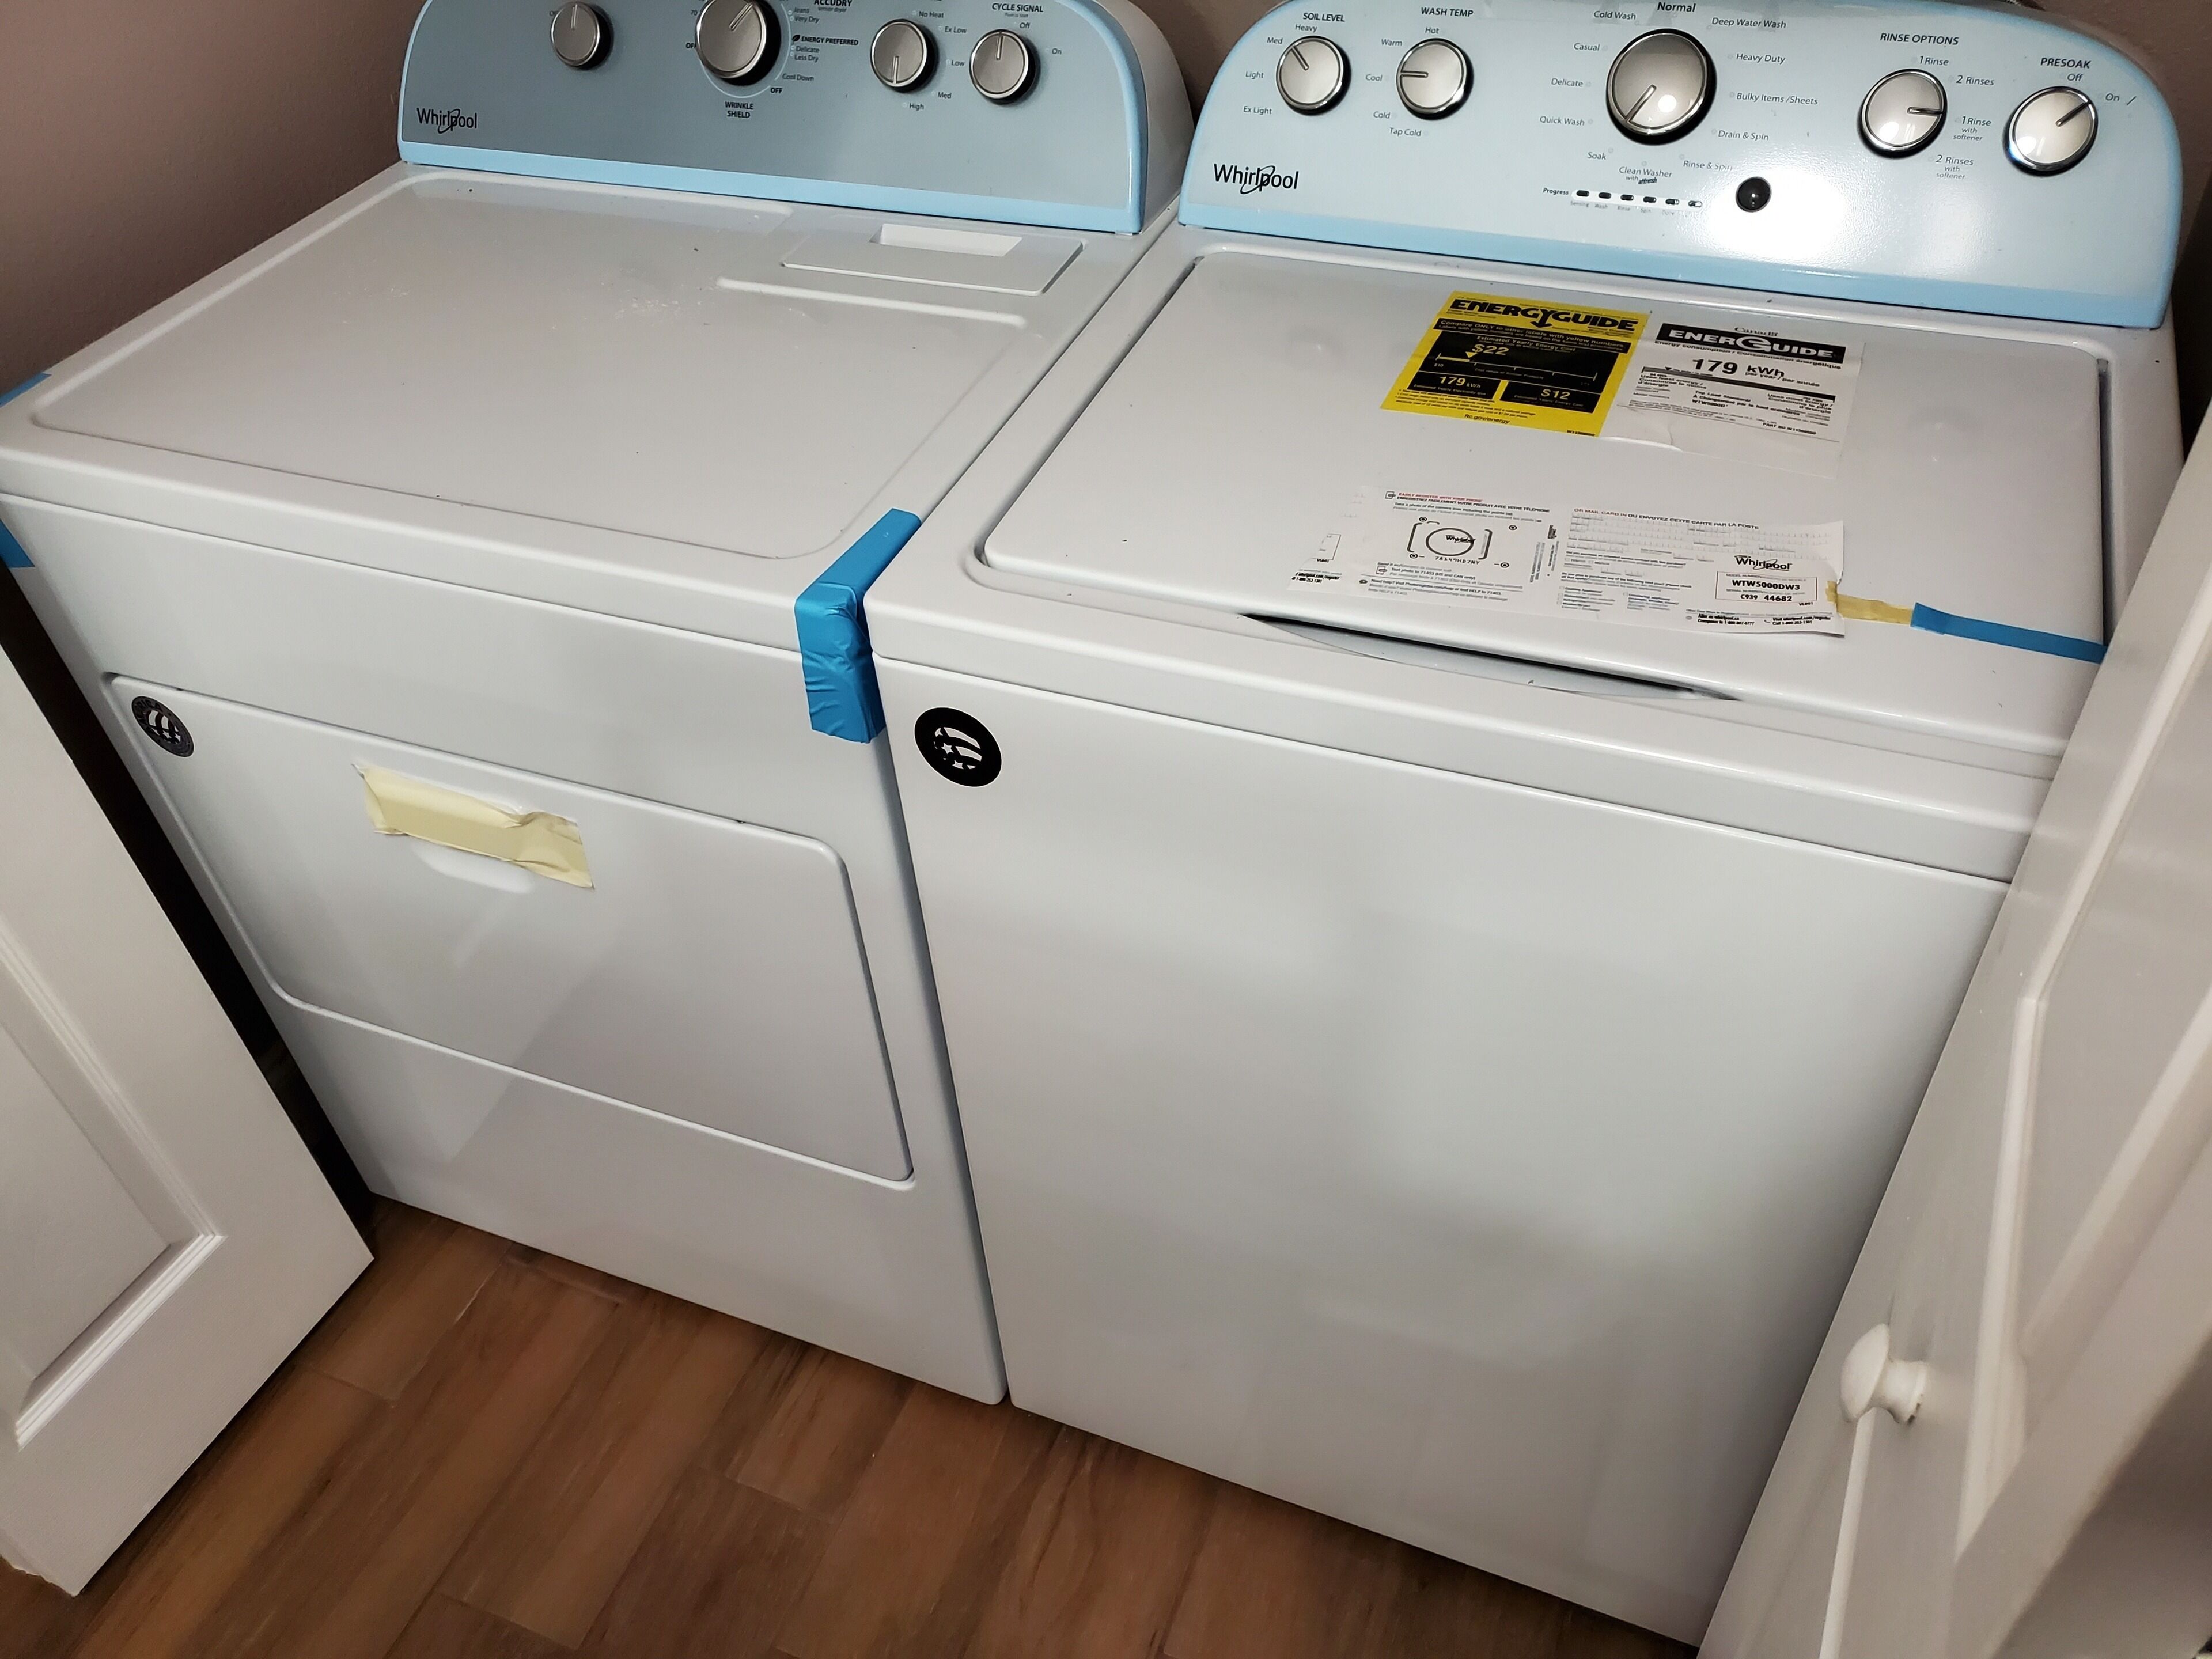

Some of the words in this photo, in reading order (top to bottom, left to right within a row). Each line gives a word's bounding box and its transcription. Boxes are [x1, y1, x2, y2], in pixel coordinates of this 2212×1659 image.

[992, 3, 1015, 11] CYCLE
[1017, 4, 1044, 13] SIGNAL
[1421, 6, 1448, 17] WASH
[1449, 8, 1474, 18] TEMP
[1657, 1, 1696, 13] Normal
[929, 10, 944, 19] Heat
[1302, 12, 1321, 21] SOIL
[1321, 13, 1346, 22] LEVEL
[1593, 10, 1612, 20] Cold
[1613, 12, 1637, 21] Wash
[1711, 17, 1732, 28] Deep
[1734, 18, 1762, 28] Water
[1764, 20, 1786, 29] Wash
[1295, 24, 1317, 33] Heavy
[1425, 26, 1439, 35] Hot
[801, 36, 824, 44] ENERGY
[825, 37, 859, 46] PREFERRED
[1267, 36, 1283, 45] Med
[1381, 38, 1403, 47] Warm
[1880, 32, 1911, 43] RINSE
[1912, 34, 1959, 46] OPTIONS
[796, 46, 820, 54] Delicate
[1573, 42, 1600, 52] Casual
[808, 55, 819, 63] Dry
[1736, 52, 1762, 64] Heavy
[1764, 54, 1786, 65] Duty
[2040, 57, 2091, 70] PRESOAK
[782, 73, 796, 81] Cool
[797, 74, 814, 82] Down
[1245, 70, 1264, 80] Light
[1365, 73, 1382, 82] Cool
[2067, 73, 2083, 82] Off
[1551, 78, 1584, 88] Delicate
[1956, 75, 1964, 85] 2
[1965, 77, 1994, 87] Rinses
[937, 91, 952, 99] Med
[1737, 92, 1760, 104] Bulky
[1762, 94, 1785, 104] Items
[1786, 95, 1819, 106] /Sheets
[2105, 92, 2120, 102] On
[725, 101, 754, 110] WRINKLE
[909, 103, 924, 111] High
[727, 110, 751, 119] SHIELD
[1243, 106, 1251, 114] Ex
[1252, 106, 1272, 116] Light
[1373, 111, 1391, 119] Cold
[416, 107, 478, 134] Whirlpool
[1540, 116, 1562, 126] Quick
[1563, 118, 1585, 127] Wash
[1389, 127, 1403, 137] Tap
[1404, 127, 1422, 137] Cold
[1718, 130, 1740, 140] Drain
[1741, 132, 1748, 140] &
[1749, 132, 1769, 142] Spin
[1953, 133, 1983, 142] softener
[1588, 151, 1606, 161] Soak
[1936, 154, 1943, 164] 2
[1945, 156, 1974, 166] Rinses
[1683, 159, 1705, 170] Rinse
[1706, 162, 1714, 170] &
[1619, 166, 1642, 176] Clean
[1643, 168, 1672, 179] Washer
[1936, 172, 1966, 180] softener
[1213, 163, 1299, 195] Whirlpool
[1638, 177, 1657, 185] affresh
[1543, 187, 1569, 196] Progress
[1450, 298, 1639, 332] ENERGYGUIDE
[1476, 335, 1510, 343] Estimated
[1512, 339, 1534, 347] Yearly
[1566, 335, 1590, 343] yellow
[1669, 329, 1834, 358] ENERGUIDE
[1472, 344, 1509, 355] $22
[1682, 343, 1730, 354] consumption
[1692, 359, 1738, 375] 179
[1747, 365, 1785, 377] kWh
[1440, 376, 1466, 387] 179
[1541, 388, 1571, 400] $12
[1734, 556, 1791, 571] Whirlpool
[1732, 579, 1800, 590] WTW5000DW3
